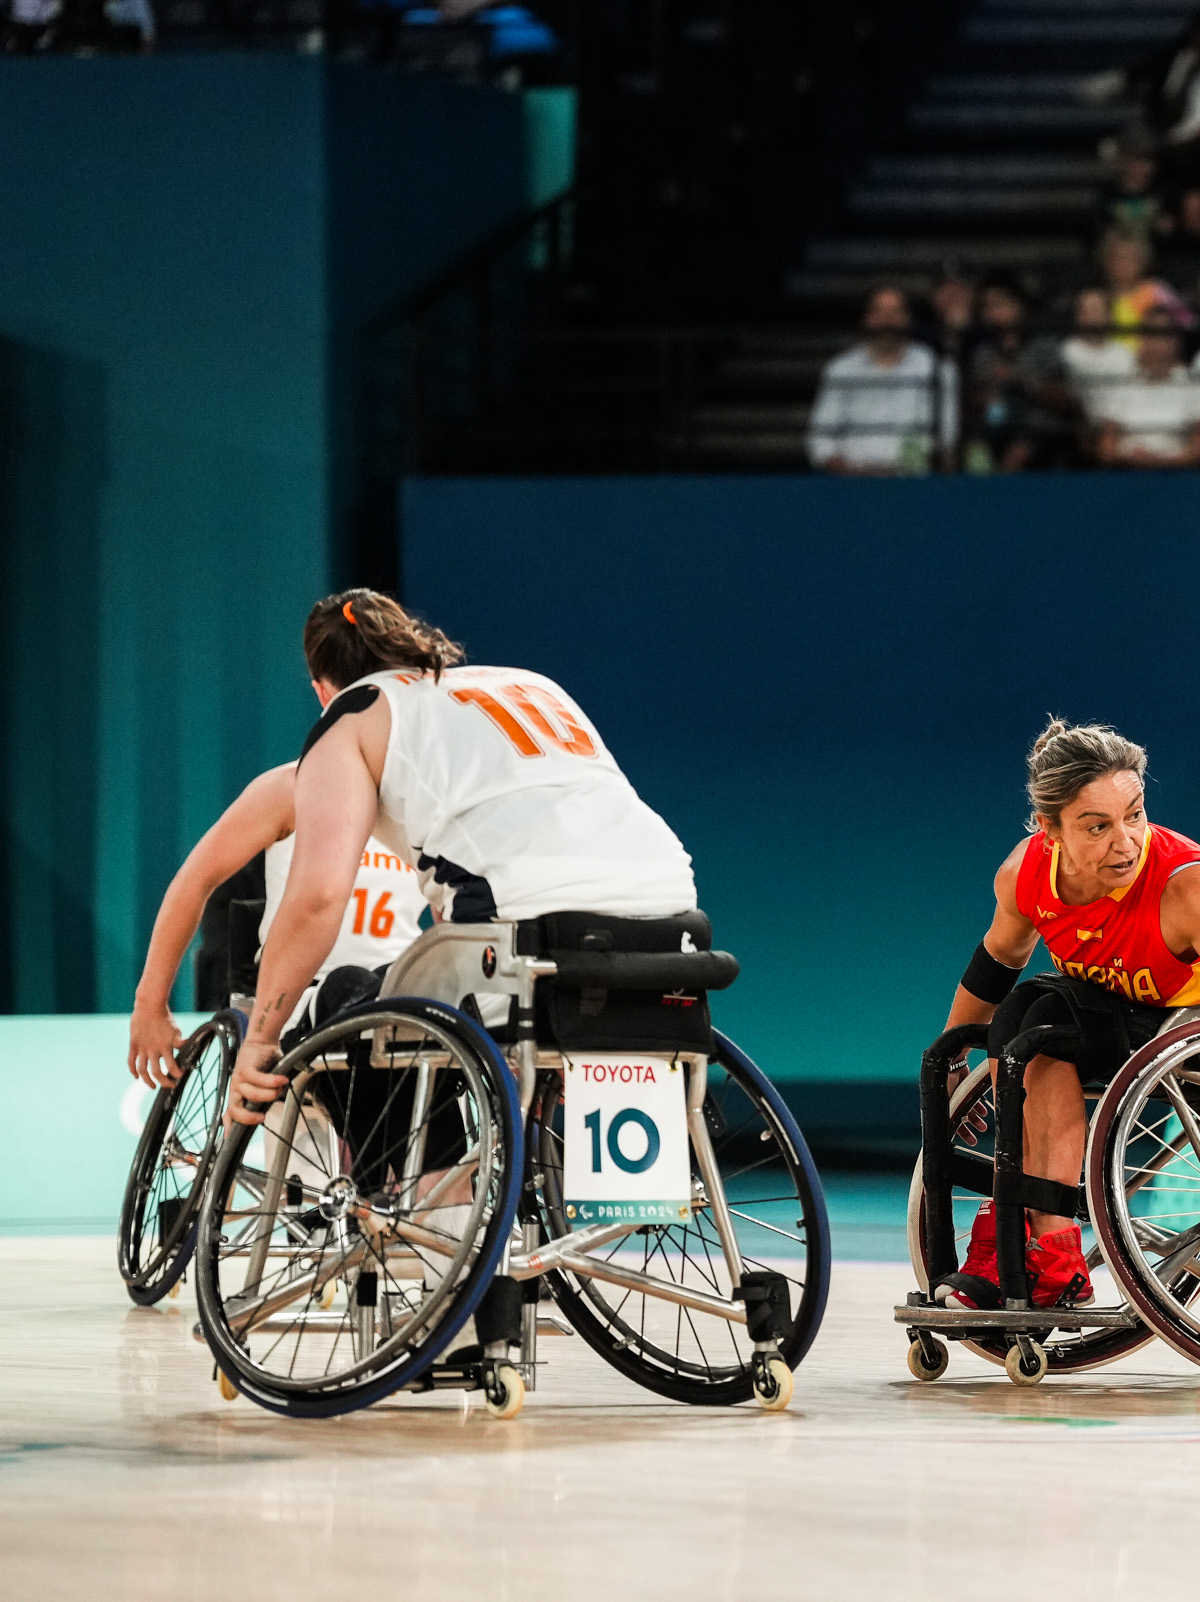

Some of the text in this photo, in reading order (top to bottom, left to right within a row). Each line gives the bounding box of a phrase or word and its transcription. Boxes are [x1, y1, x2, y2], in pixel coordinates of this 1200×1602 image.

[448, 683, 600, 759] 10
[352, 888, 395, 939] 16
[581, 1064, 656, 1084] TOYOTA
[584, 1107, 661, 1174] 10
[598, 1205, 673, 1218] PARIS 2024
